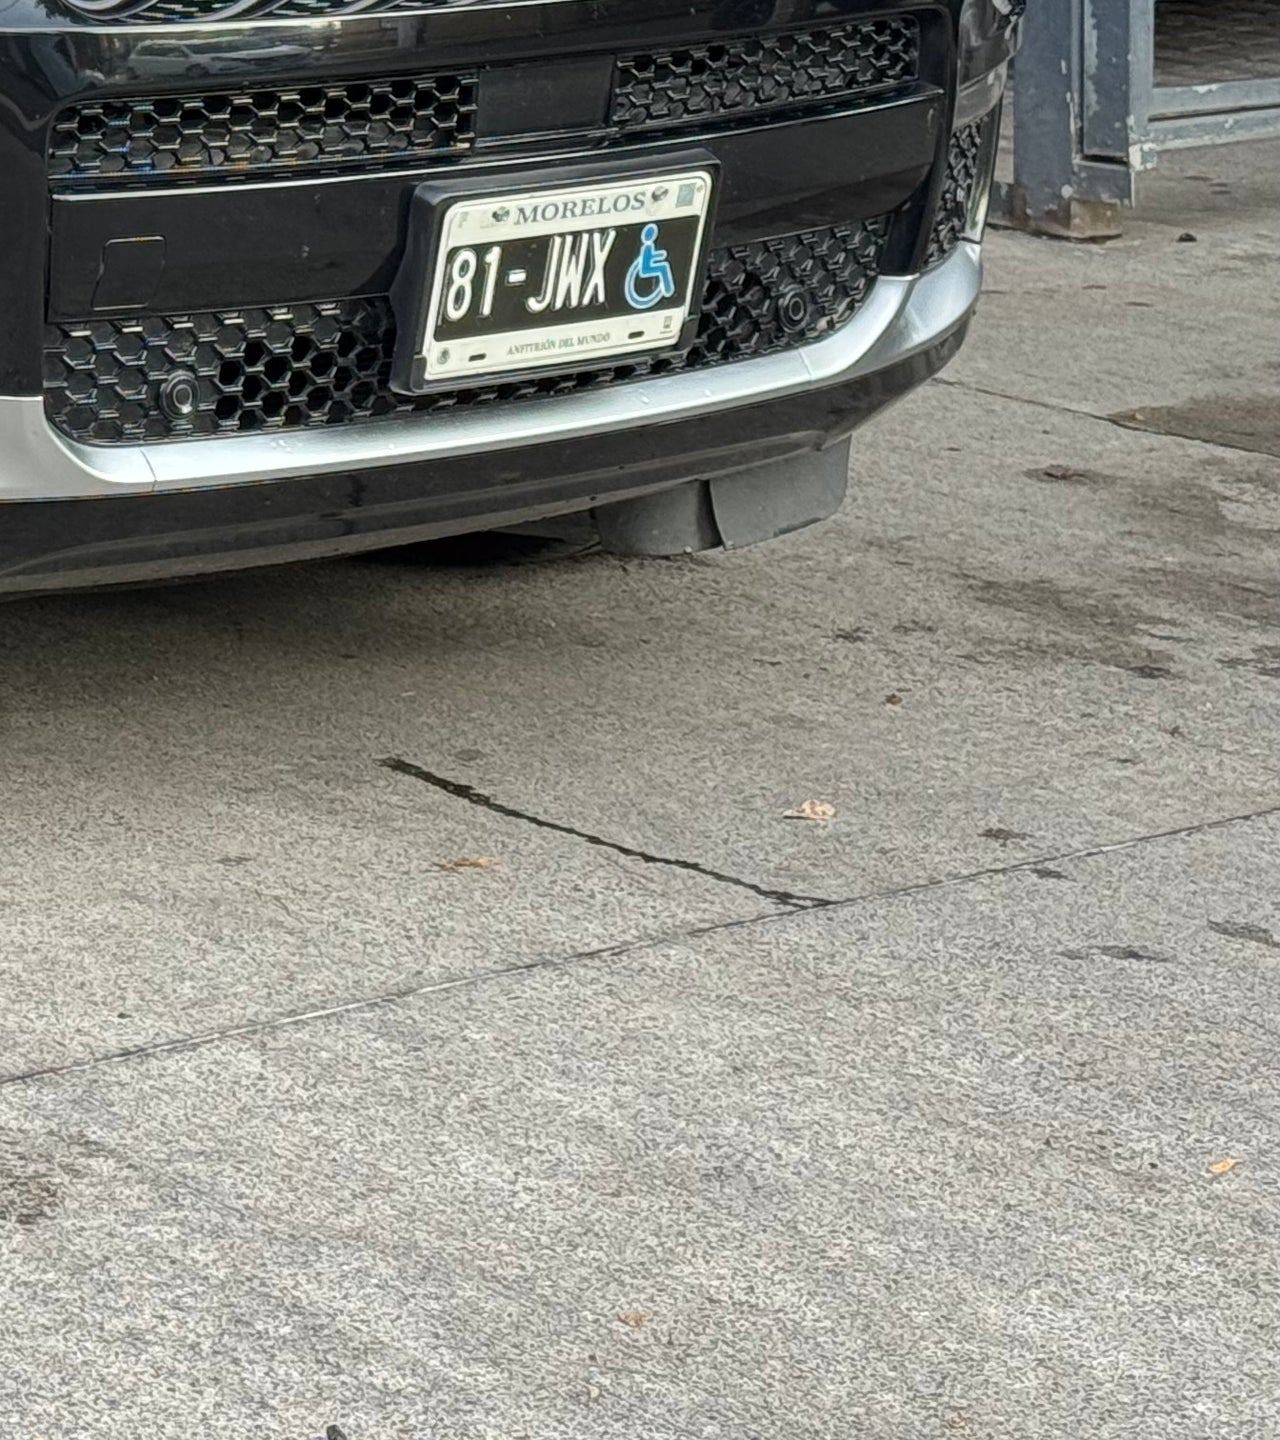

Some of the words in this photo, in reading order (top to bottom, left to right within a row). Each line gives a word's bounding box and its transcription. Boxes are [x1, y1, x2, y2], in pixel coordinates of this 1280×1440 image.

[513, 192, 646, 225] MORELOS
[445, 228, 616, 321] 81-JWX
[558, 337, 576, 350] DEL
[576, 331, 611, 346] MUNDO
